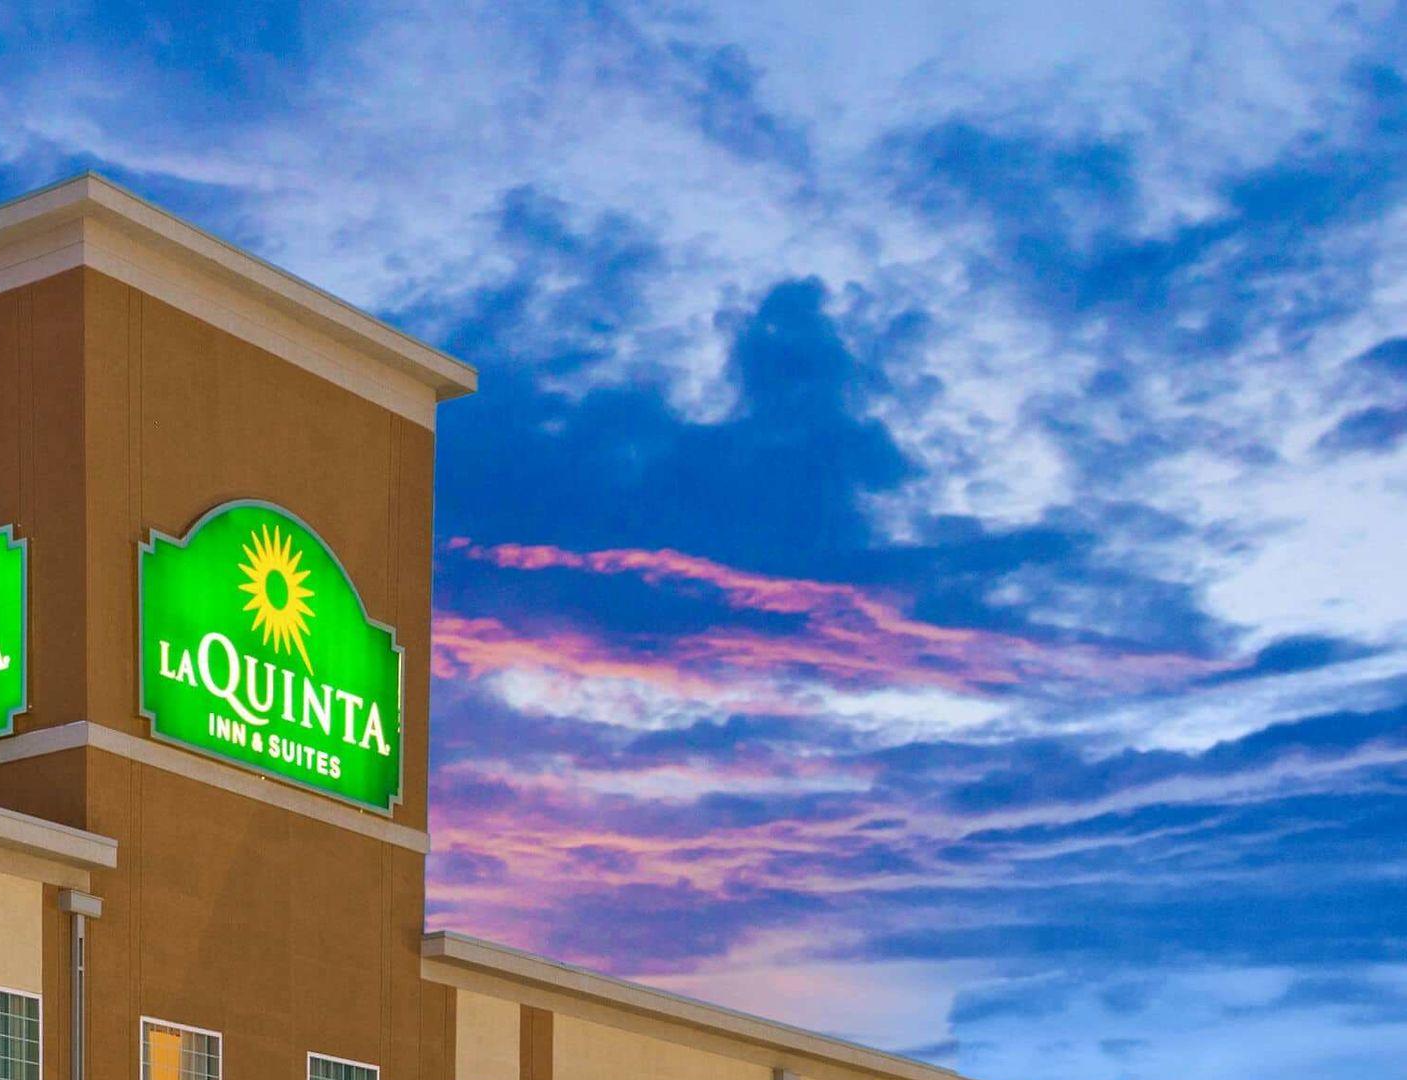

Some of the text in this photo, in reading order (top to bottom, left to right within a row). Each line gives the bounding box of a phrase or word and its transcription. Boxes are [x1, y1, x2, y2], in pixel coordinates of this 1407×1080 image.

[159, 632, 391, 756] LA QUINTA
[209, 712, 342, 779] INN & SUITES
